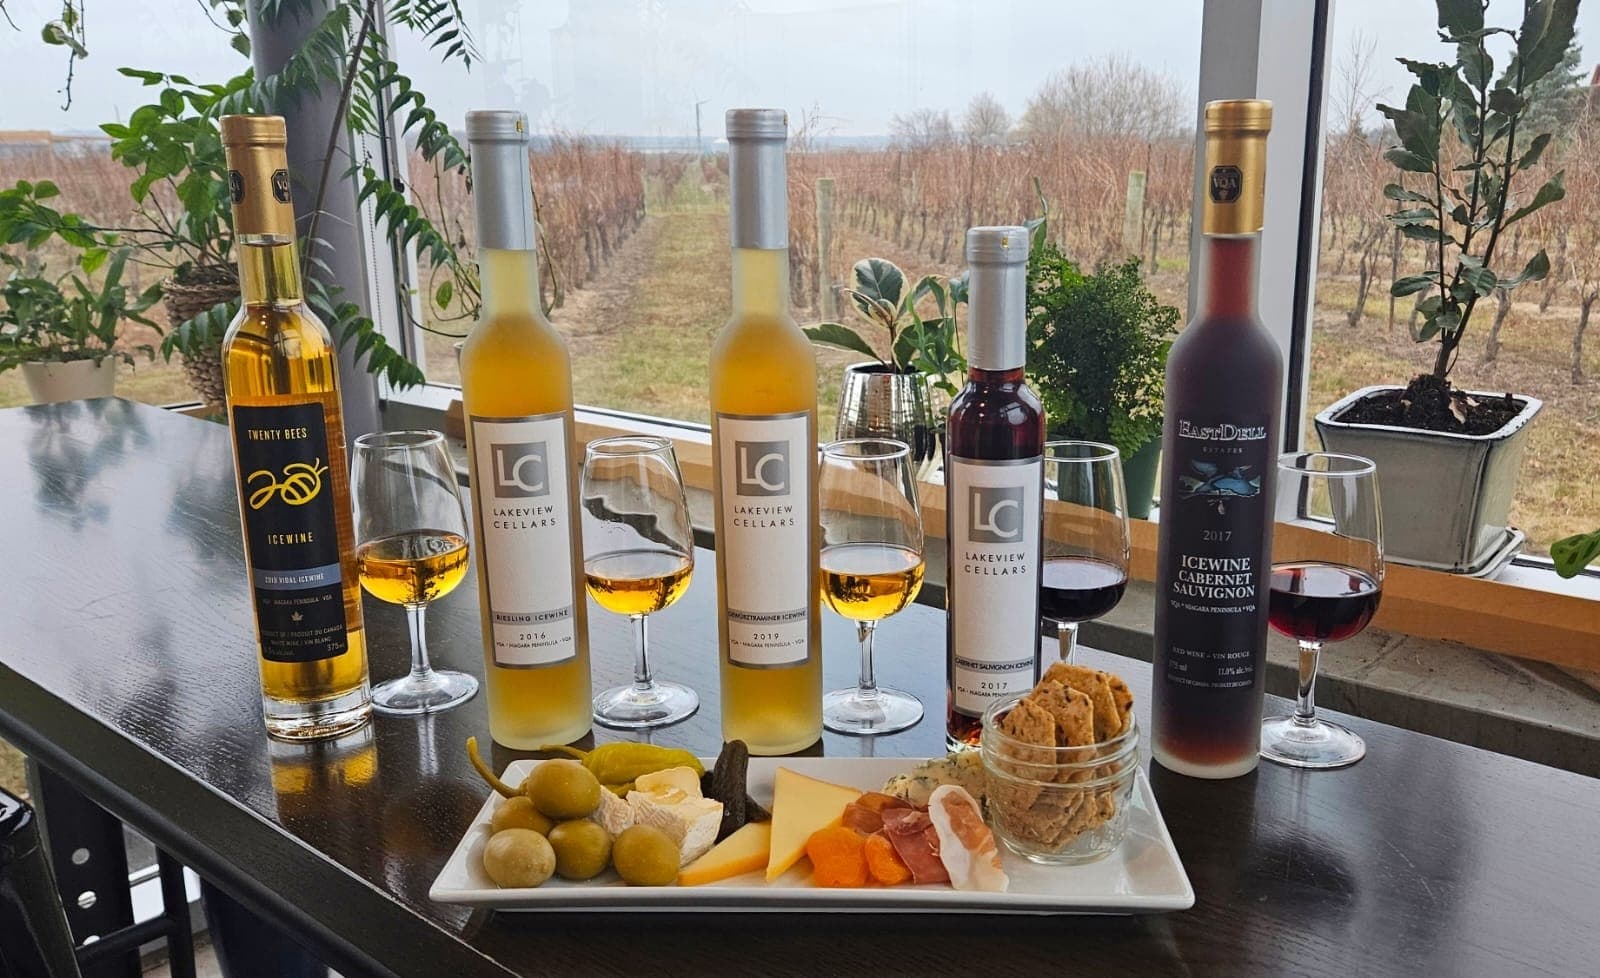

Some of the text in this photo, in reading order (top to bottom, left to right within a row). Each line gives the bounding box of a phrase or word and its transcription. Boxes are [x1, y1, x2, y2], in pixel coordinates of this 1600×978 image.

[248, 428, 307, 440] TWENTY BEES
[1202, 446, 1243, 454] ESTATES
[494, 505, 553, 517] LAKEVIEW
[734, 505, 793, 515] LAKEVIEW
[494, 518, 556, 529] CELLARS
[734, 518, 794, 528] CELLARS
[268, 532, 313, 545] ICEWINE
[1203, 530, 1232, 541] 2017
[965, 552, 1025, 563] LAKEVIEW
[1182, 554, 1251, 572] ICEWINE
[964, 564, 1026, 576] CELLARS
[279, 576, 297, 584] VIDAL
[1178, 570, 1252, 586] CABERNET
[1173, 581, 1255, 599] SAUVIGNON
[496, 609, 569, 622] RIESLING ICEWINE
[782, 610, 806, 620] ICEWINE
[519, 632, 546, 641] 2016
[1186, 649, 1206, 659] WINE
[981, 682, 1008, 690] 2017
[969, 690, 991, 698] NIAGARA
